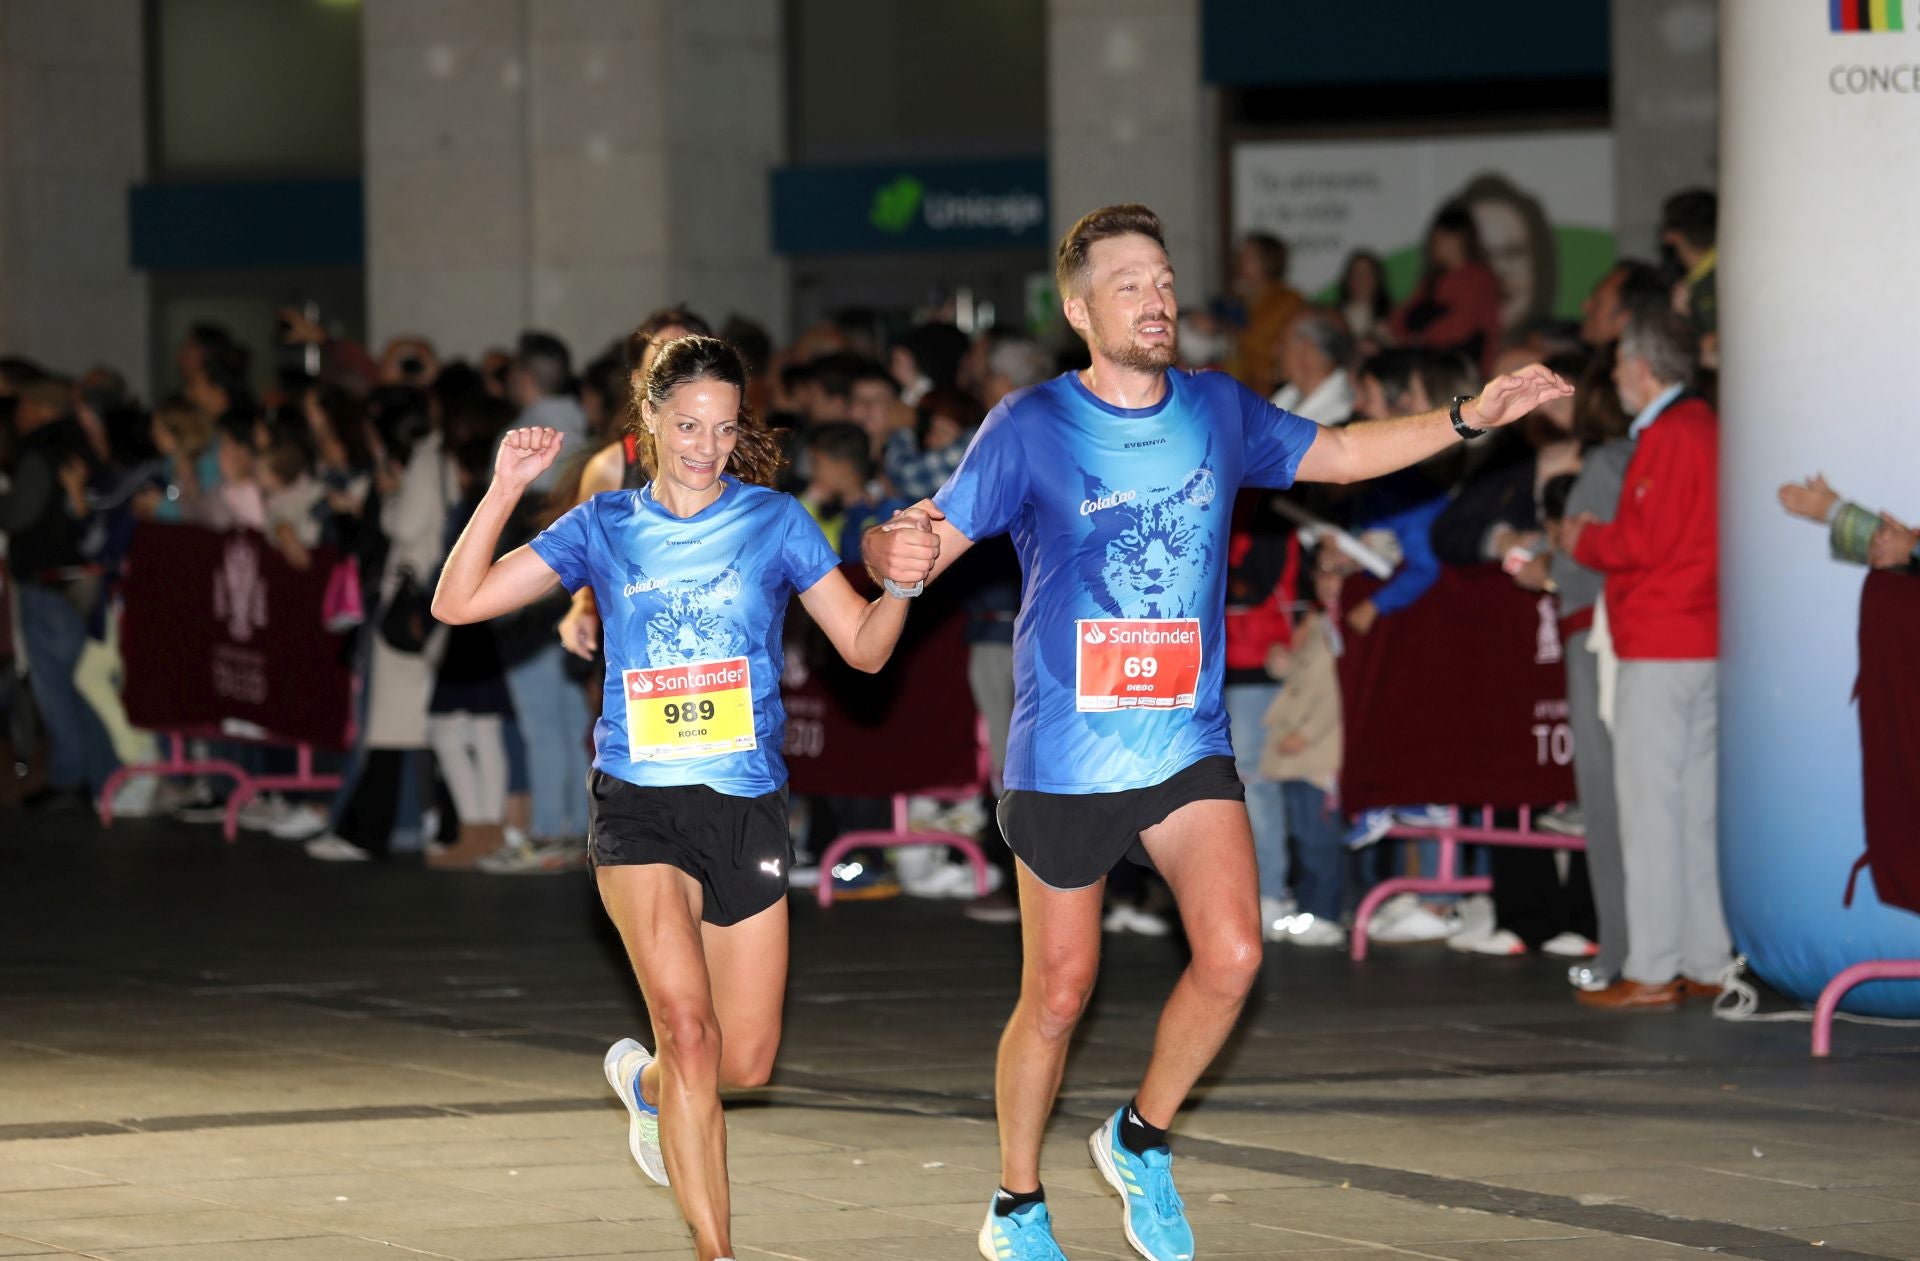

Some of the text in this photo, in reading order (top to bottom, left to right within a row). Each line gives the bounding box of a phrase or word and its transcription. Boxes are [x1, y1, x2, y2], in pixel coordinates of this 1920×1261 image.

[923, 192, 1043, 234] Unicaja
[1124, 438, 1166, 449] EVERNYA
[1079, 489, 1136, 516] ColaCao
[623, 577, 668, 598] ColaCao
[1109, 627, 1196, 644] Santander
[1124, 656, 1157, 678] 69
[655, 668, 744, 691] Santander
[1126, 684, 1154, 692] DIEGO
[664, 699, 715, 725] 989
[678, 729, 708, 738] ROCIO
